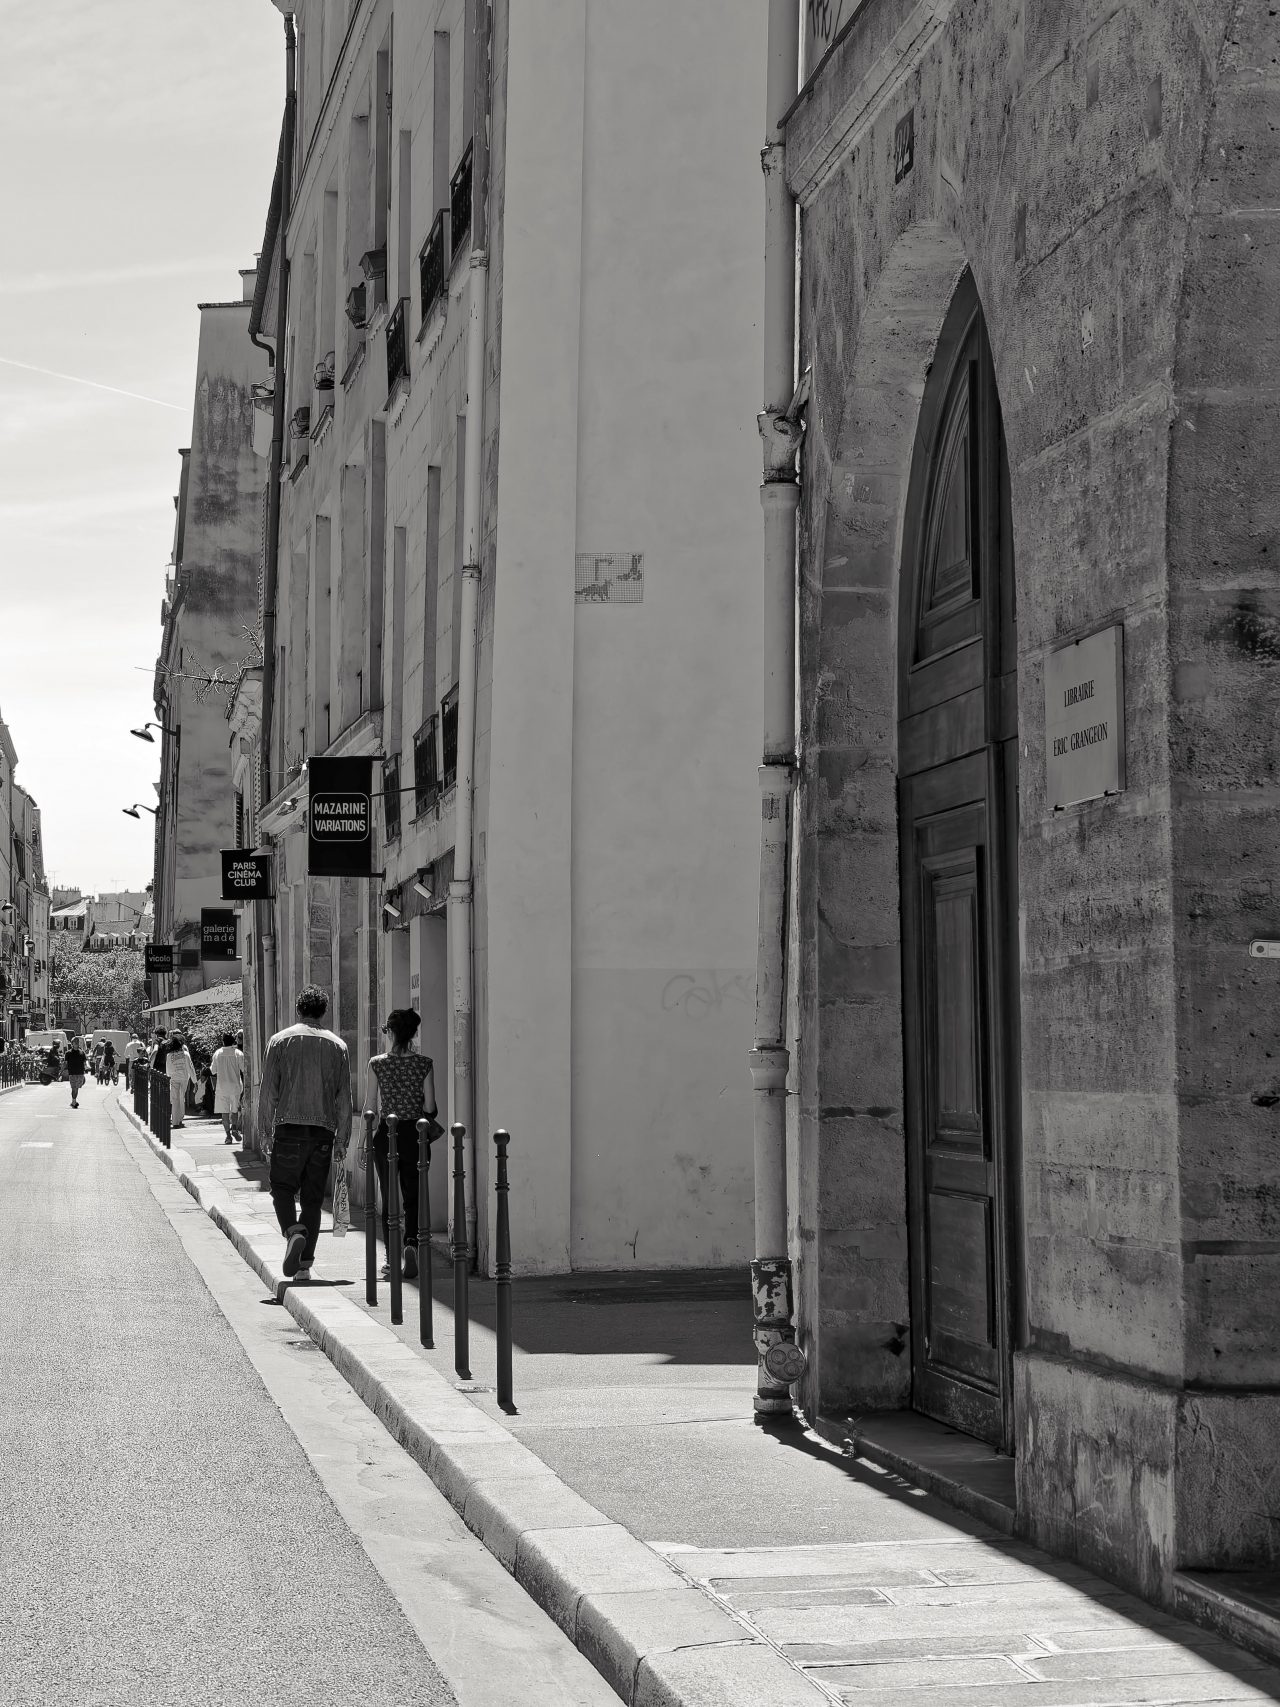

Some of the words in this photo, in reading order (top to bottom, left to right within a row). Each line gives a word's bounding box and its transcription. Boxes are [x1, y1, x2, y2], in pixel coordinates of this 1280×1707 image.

[1063, 679, 1095, 708] LIBRAIRIE
[1070, 721, 1108, 752] GRANGEON
[314, 802, 366, 815] MAZARINE
[314, 819, 366, 832] VARIATIONS
[232, 861, 257, 870] PARIS
[227, 869, 262, 879] CINÉMA
[233, 878, 257, 887] CLUB
[203, 924, 235, 935] galerie
[203, 932, 235, 942] madé
[148, 954, 171, 962] vicolo
